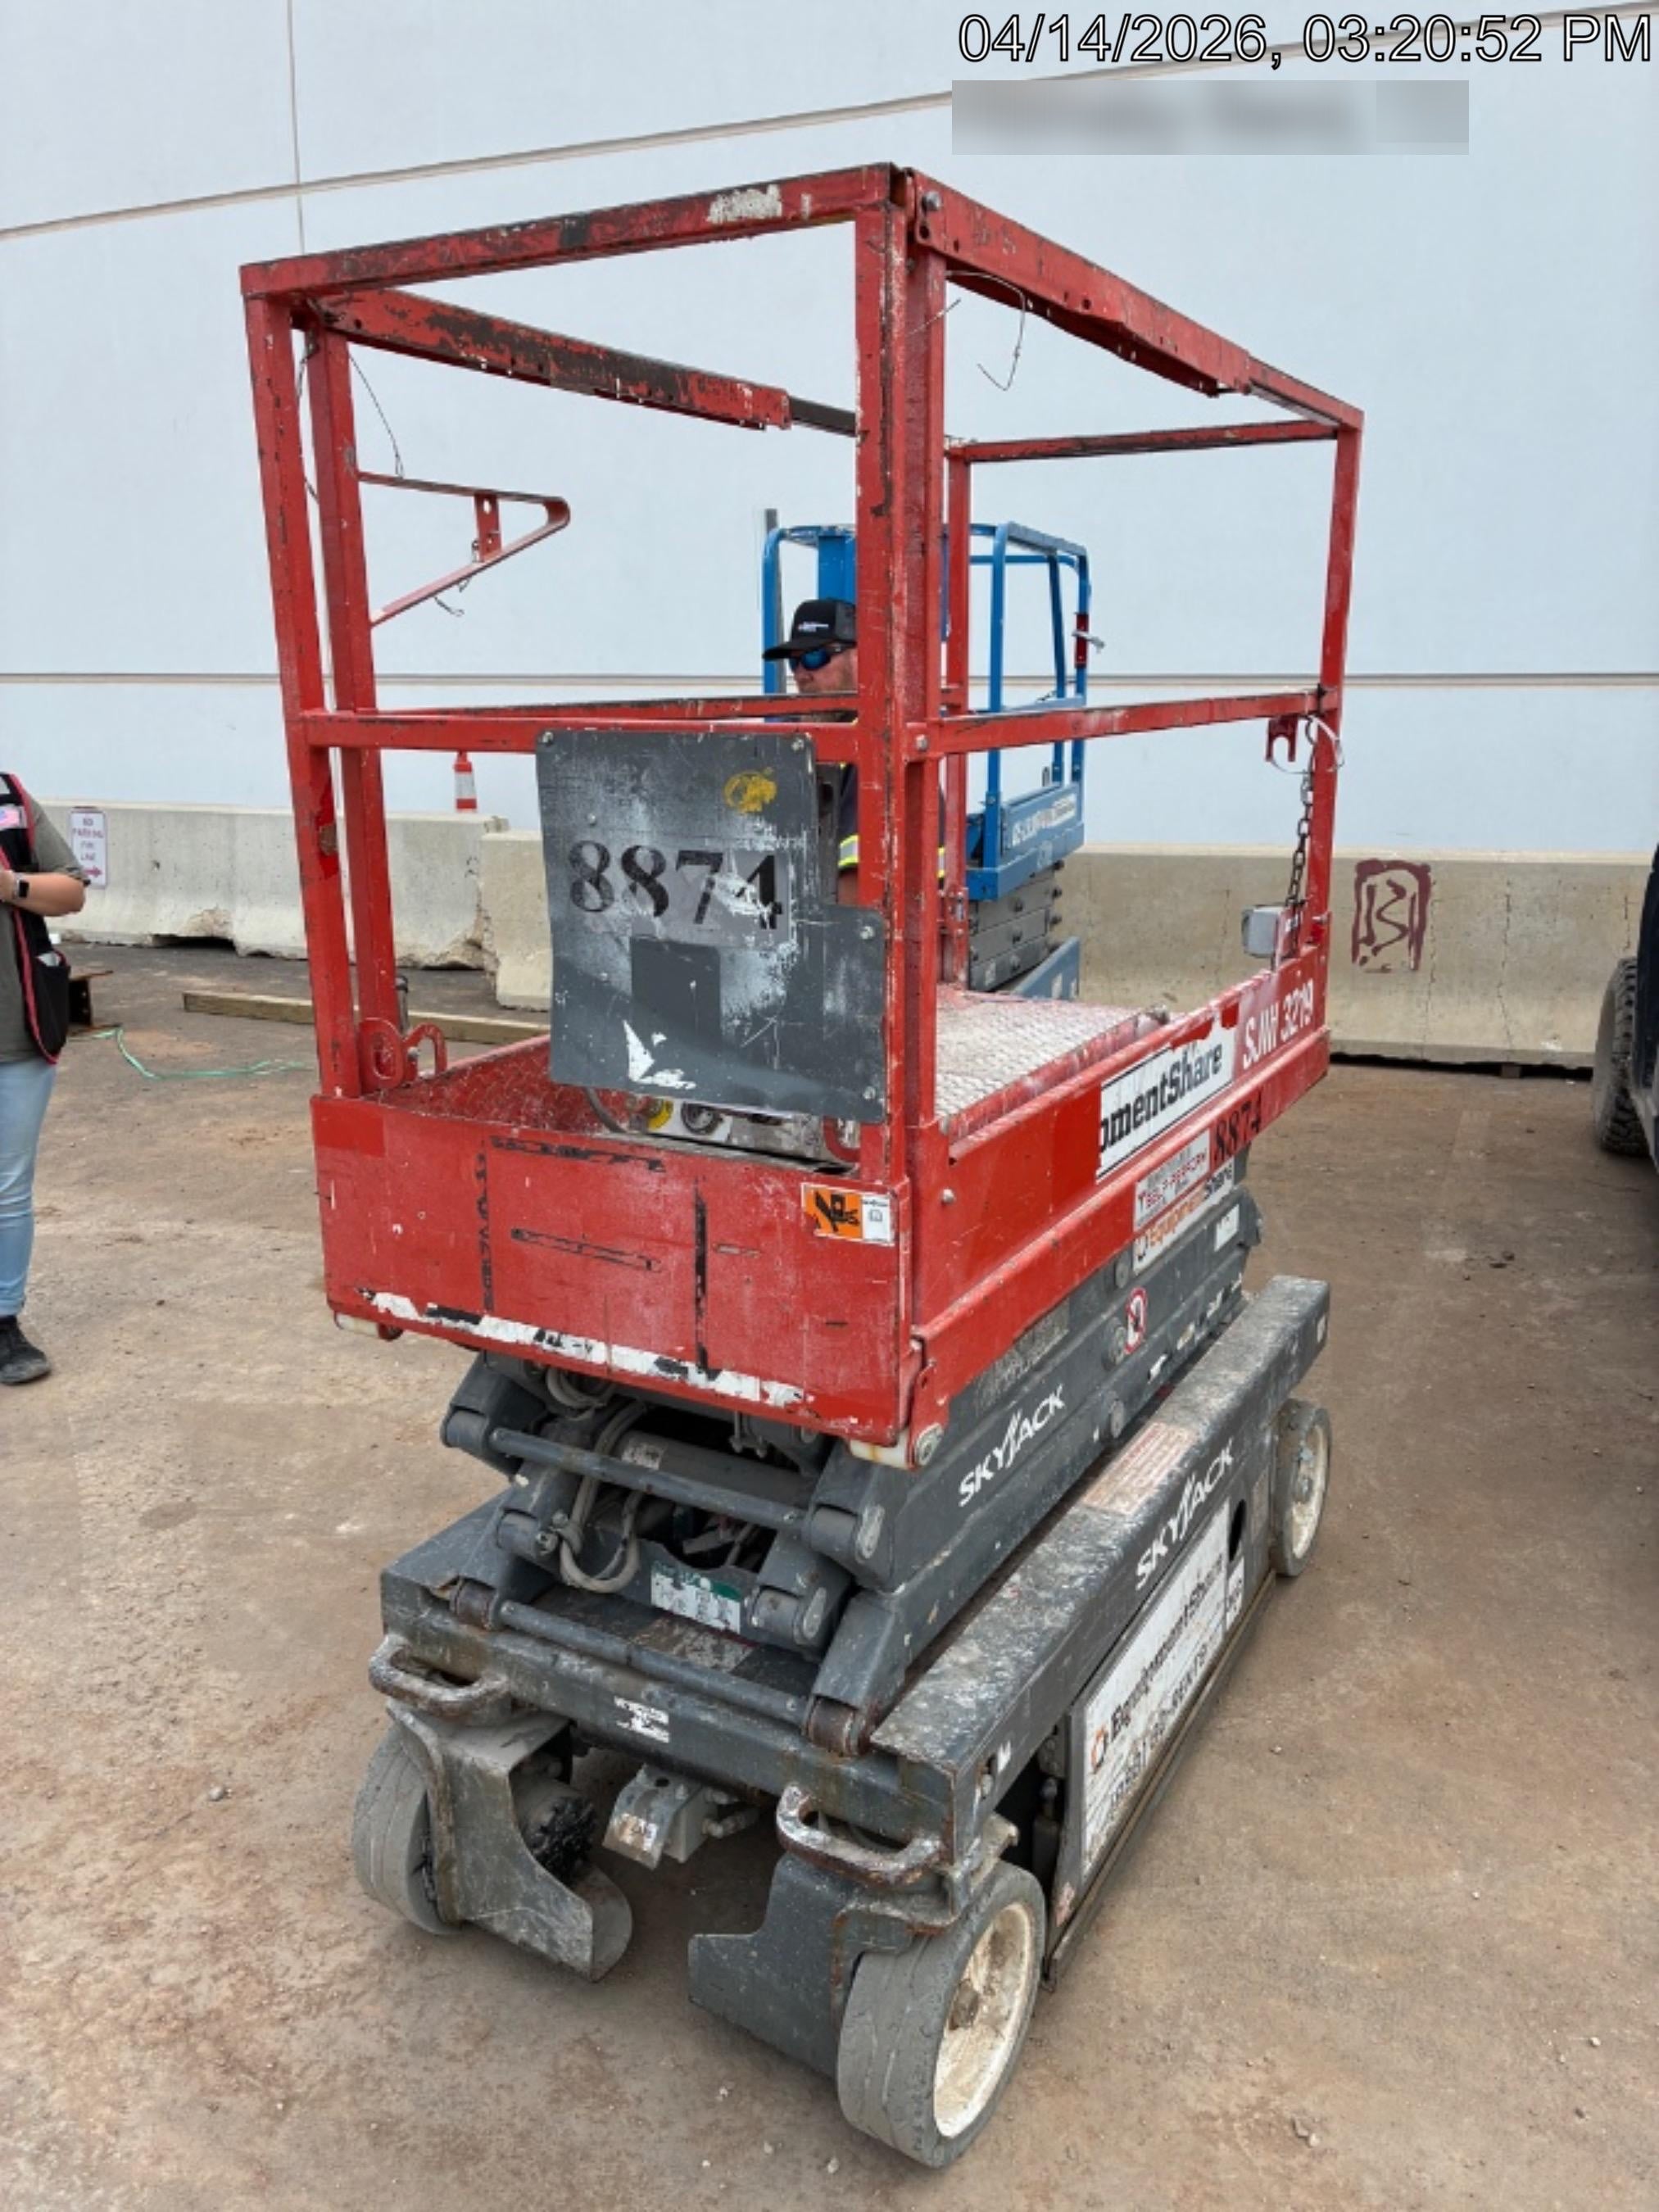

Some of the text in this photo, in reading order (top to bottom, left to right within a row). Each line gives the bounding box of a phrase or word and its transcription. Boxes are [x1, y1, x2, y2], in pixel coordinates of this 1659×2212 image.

[568, 840, 783, 930] 8874
[1214, 1090, 1262, 1163] 8874
[958, 1385, 1065, 1507] SKYJACK
[1135, 1438, 1234, 1591] SKYJACK
